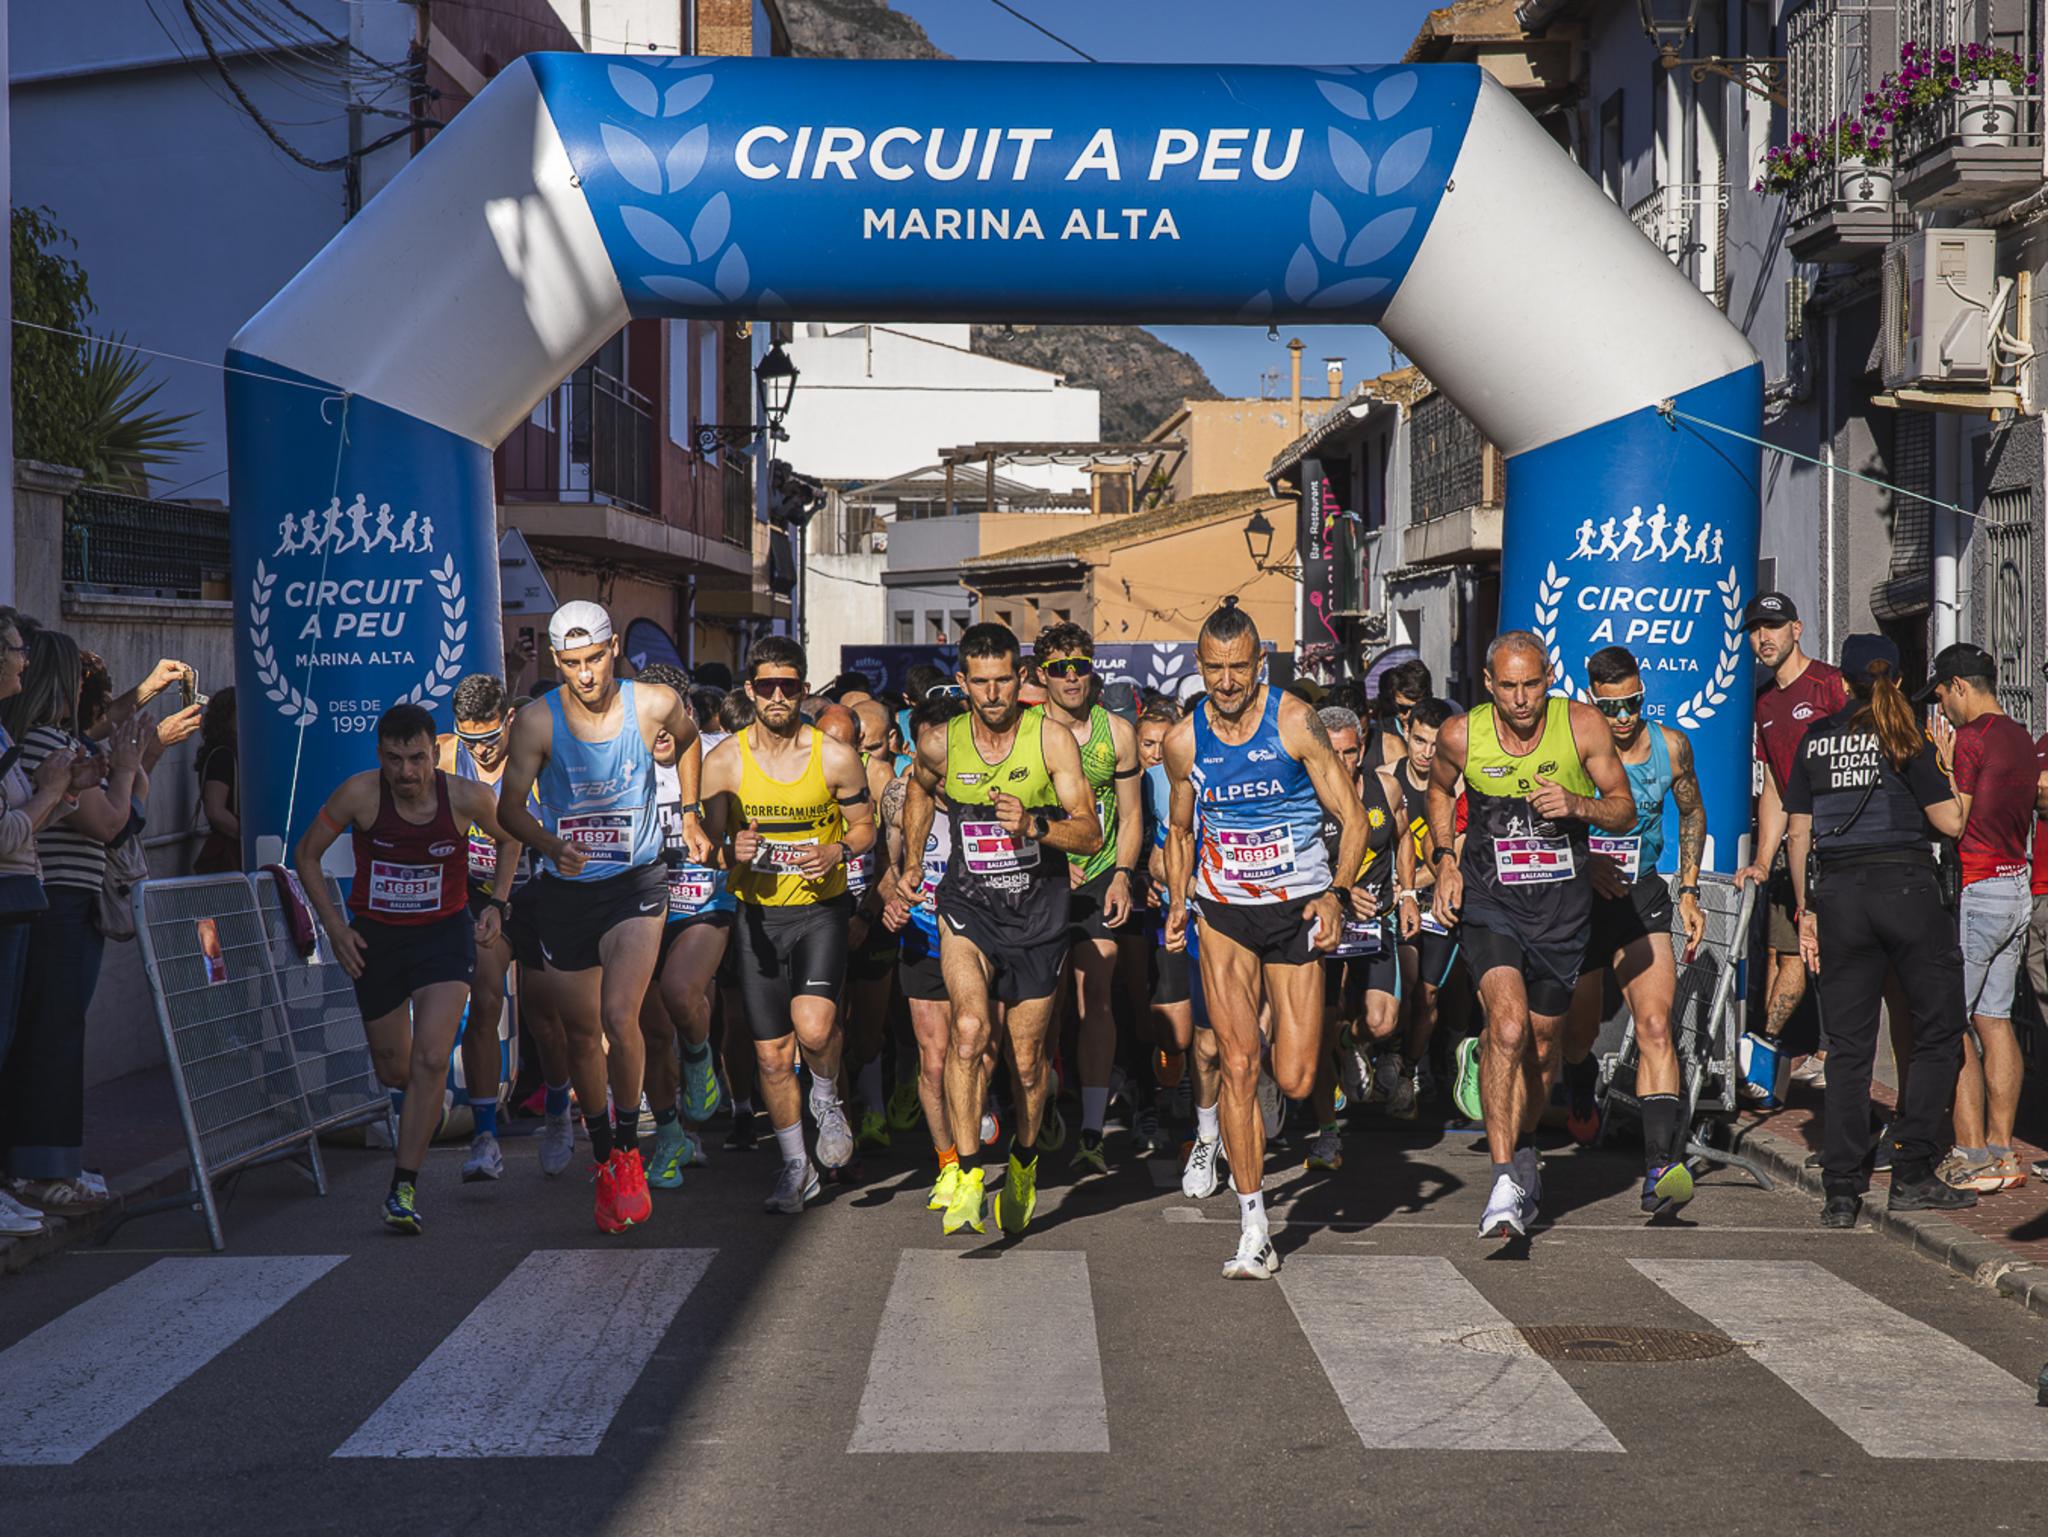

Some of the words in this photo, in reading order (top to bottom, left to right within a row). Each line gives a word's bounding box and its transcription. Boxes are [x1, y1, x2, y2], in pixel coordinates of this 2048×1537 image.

[734, 125, 1053, 181] CIRCUIT
[1064, 128, 1121, 181] A
[1148, 128, 1304, 181] PEU
[863, 208, 1045, 240] MARINA
[1060, 208, 1181, 240] ALTA
[1309, 480, 1320, 534] Restaurant
[1309, 541, 1320, 559] Bar
[285, 579, 423, 607] CIRCUIT
[1577, 586, 1711, 613] CIRCUIT
[298, 613, 323, 639] A
[333, 612, 406, 638] PEU
[1589, 618, 1614, 643] A
[1625, 619, 1694, 644] PEU
[295, 652, 363, 667] MARINA
[368, 651, 415, 665] ALTA
[1093, 659, 1127, 669] ULAR
[1657, 658, 1699, 672] ALTA
[329, 700, 357, 712] DES
[361, 700, 381, 711] DE
[1648, 705, 1665, 716] DE
[332, 715, 379, 733] 1997
[1807, 733, 1879, 759] POLICIA
[1830, 752, 1879, 770] LOCAL
[1203, 779, 1285, 802] ALPESA
[576, 831, 616, 842] 1697
[996, 841, 1004, 851] 1
[1236, 847, 1276, 862] 1698
[1529, 854, 1540, 864] 2
[387, 882, 425, 894] 1683
